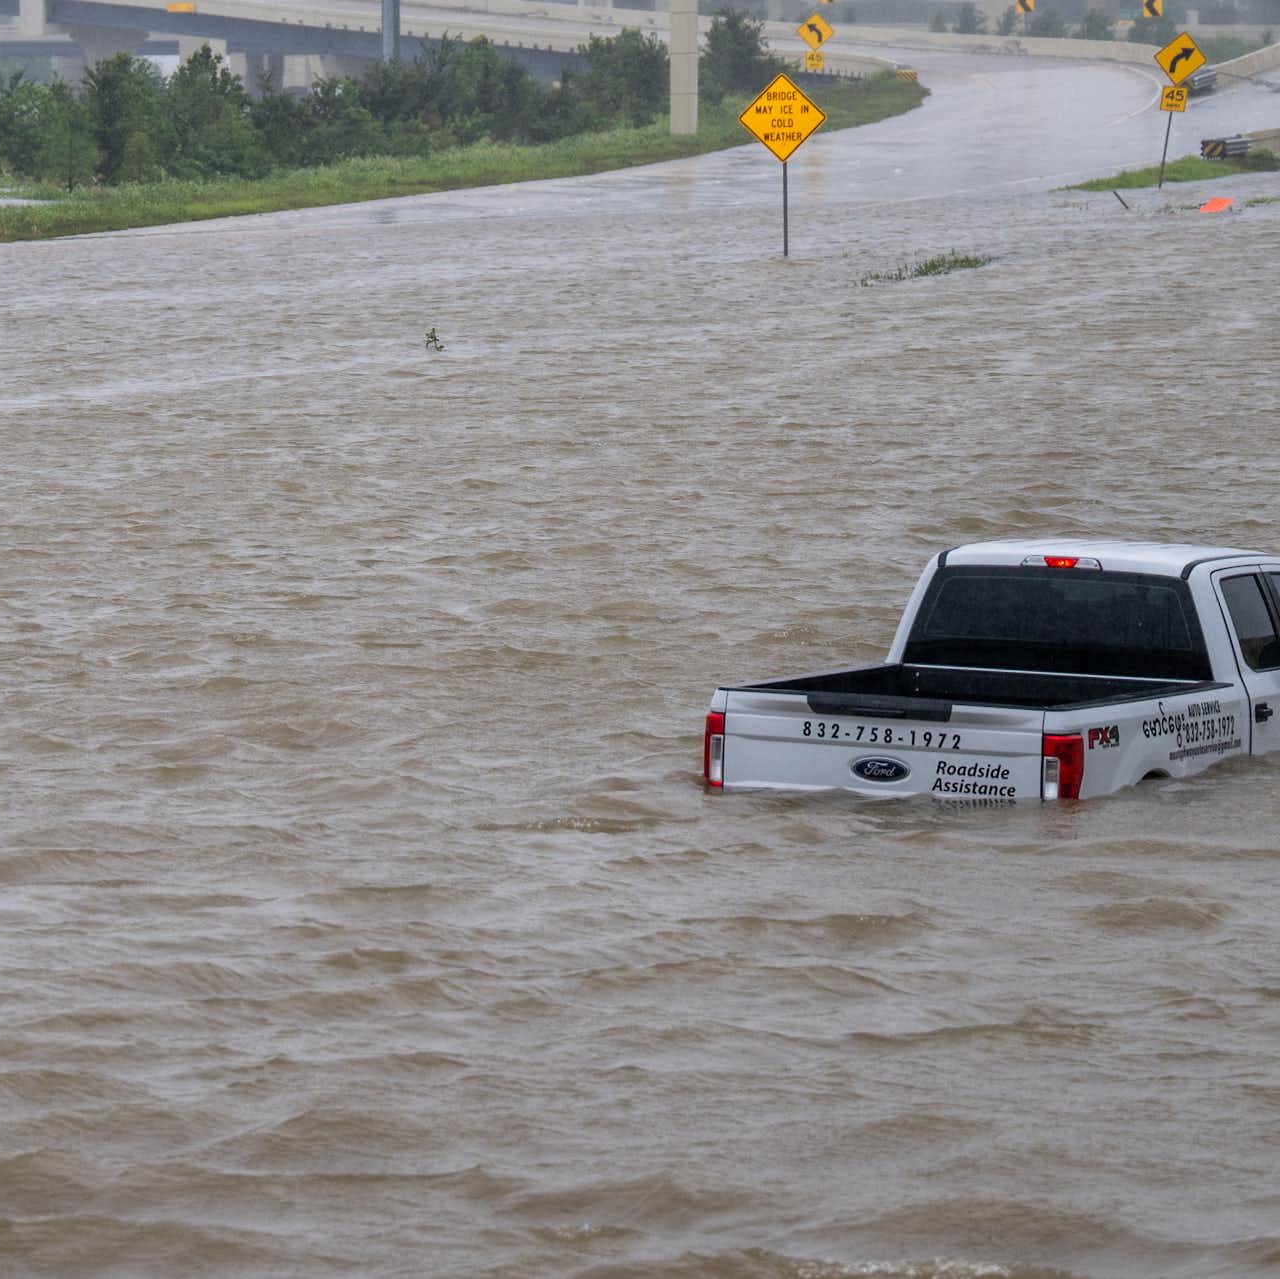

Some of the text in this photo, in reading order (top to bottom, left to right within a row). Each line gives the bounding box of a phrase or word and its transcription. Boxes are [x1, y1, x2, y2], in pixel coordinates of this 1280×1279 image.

[766, 91, 798, 101] BRIDGE
[1165, 90, 1185, 101] 45
[755, 104, 810, 114] MAY ICE IN
[771, 118, 794, 128] COLD
[763, 131, 803, 141] WEATHER
[1187, 700, 1221, 718] AUTO SERVICE
[802, 721, 962, 750] 832-758-1972
[1088, 725, 1120, 750] FX4
[1185, 715, 1236, 744] 832-758-1972
[863, 761, 896, 778] Ford
[935, 760, 1011, 779] Roadside
[931, 777, 1017, 797] Assistance
